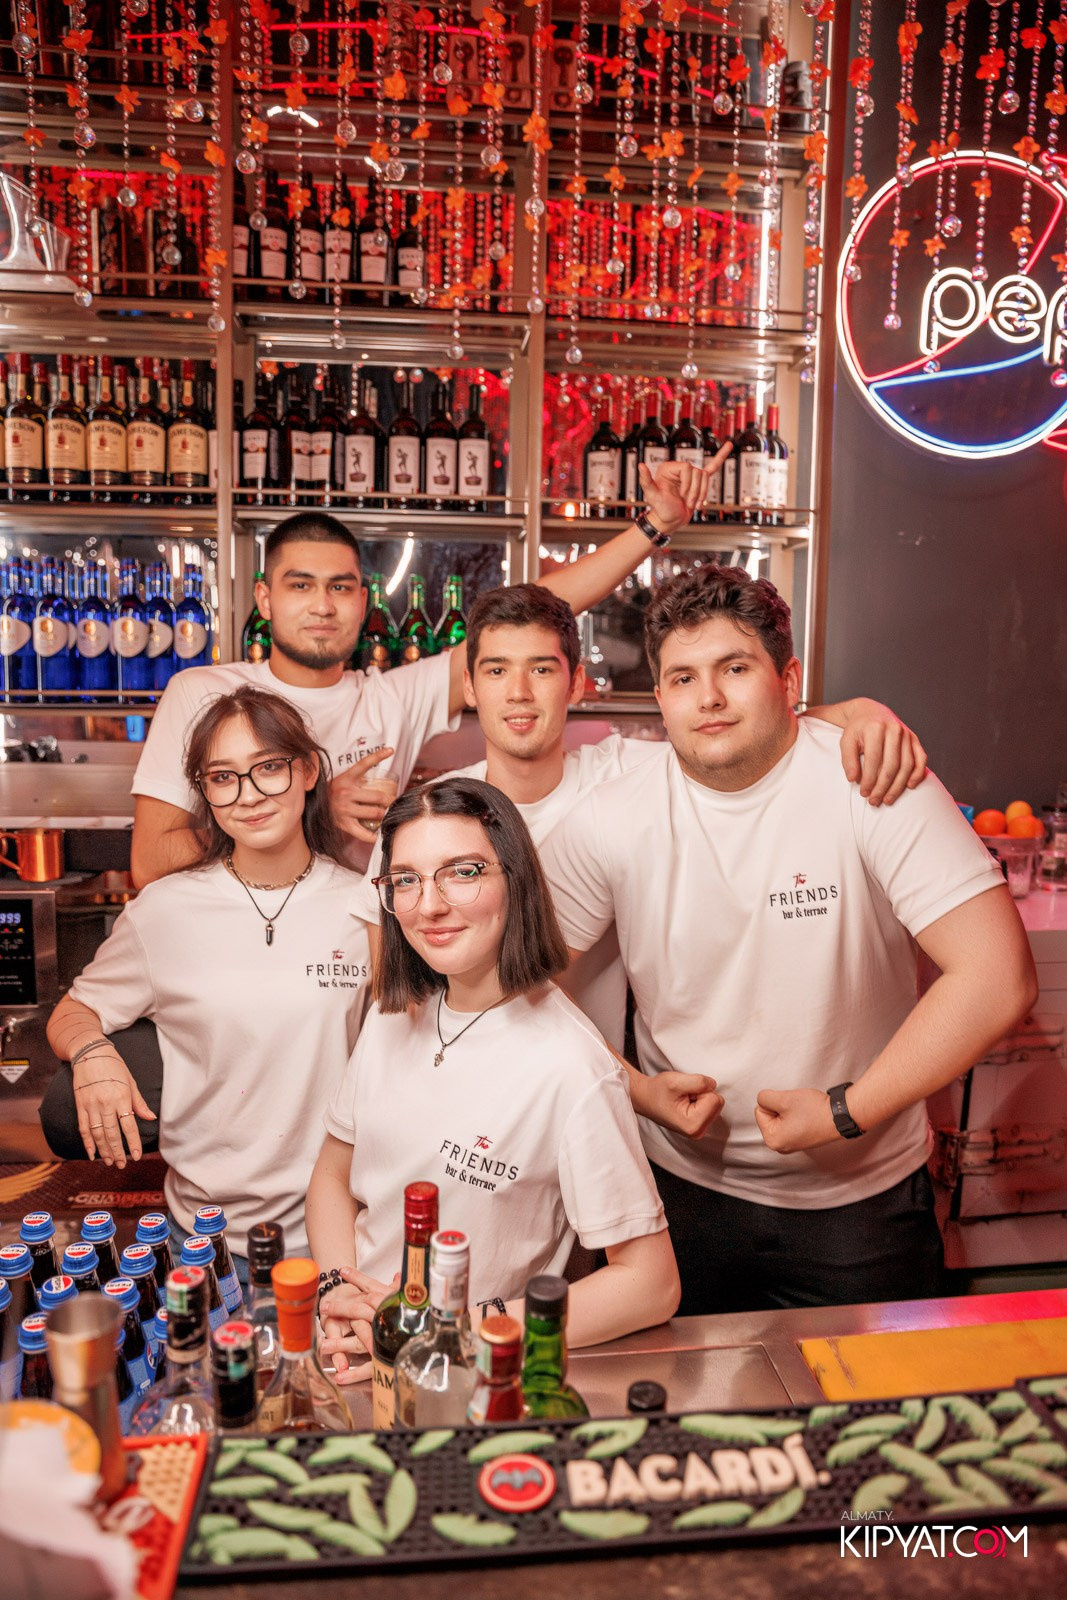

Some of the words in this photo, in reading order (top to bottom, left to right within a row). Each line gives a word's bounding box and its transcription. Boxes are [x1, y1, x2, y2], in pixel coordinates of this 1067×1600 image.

[792, 873, 807, 888] The
[769, 885, 839, 907] FRIENDS
[782, 909, 793, 920] bar
[795, 907, 803, 918] &
[803, 906, 828, 917] terrace
[306, 963, 367, 977] FRIENDS
[331, 978, 338, 988] &
[473, 1135, 493, 1150] The
[439, 1139, 519, 1181] FRIENDS
[445, 1162, 458, 1178] bar
[459, 1169, 467, 1182] &
[468, 1174, 497, 1192] terrace
